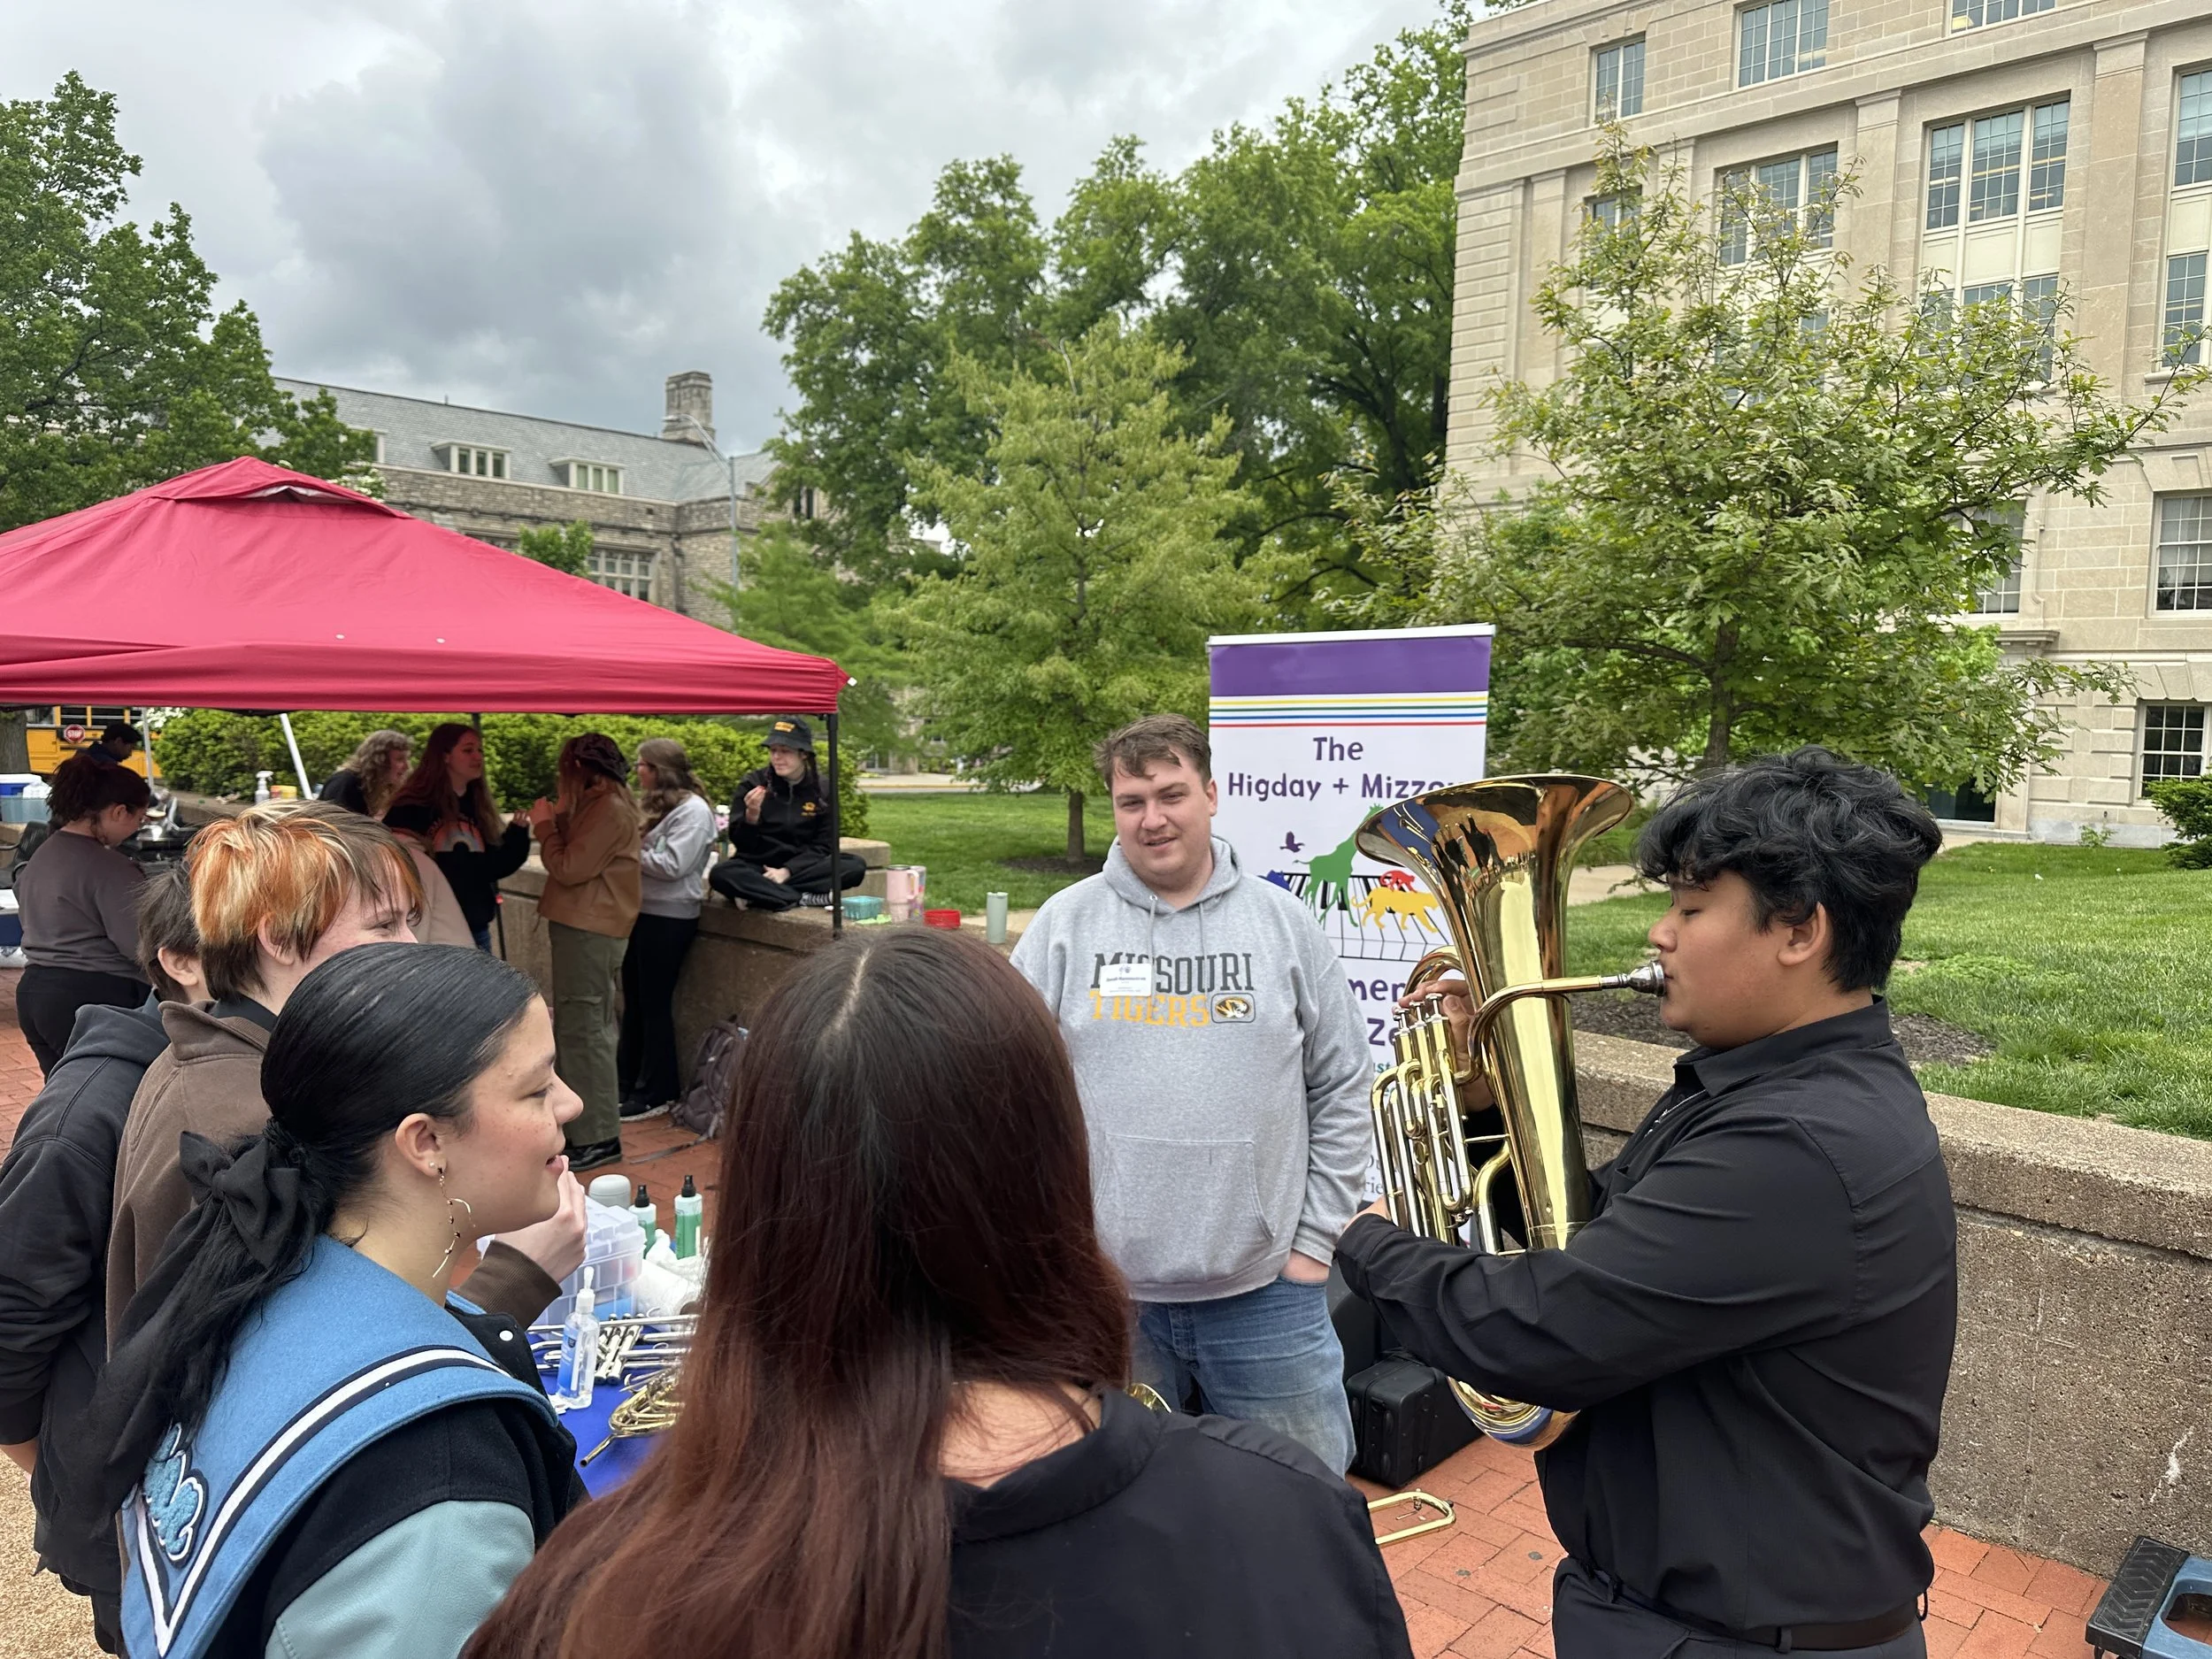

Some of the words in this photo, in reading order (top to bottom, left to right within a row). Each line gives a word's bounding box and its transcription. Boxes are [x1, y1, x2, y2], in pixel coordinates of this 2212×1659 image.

[1312, 736, 1363, 761] The
[1228, 772, 1322, 802] Higday
[1333, 778, 1349, 795] +
[1361, 773, 1454, 799] Mizz
[1088, 988, 1210, 1027] TIGERS
